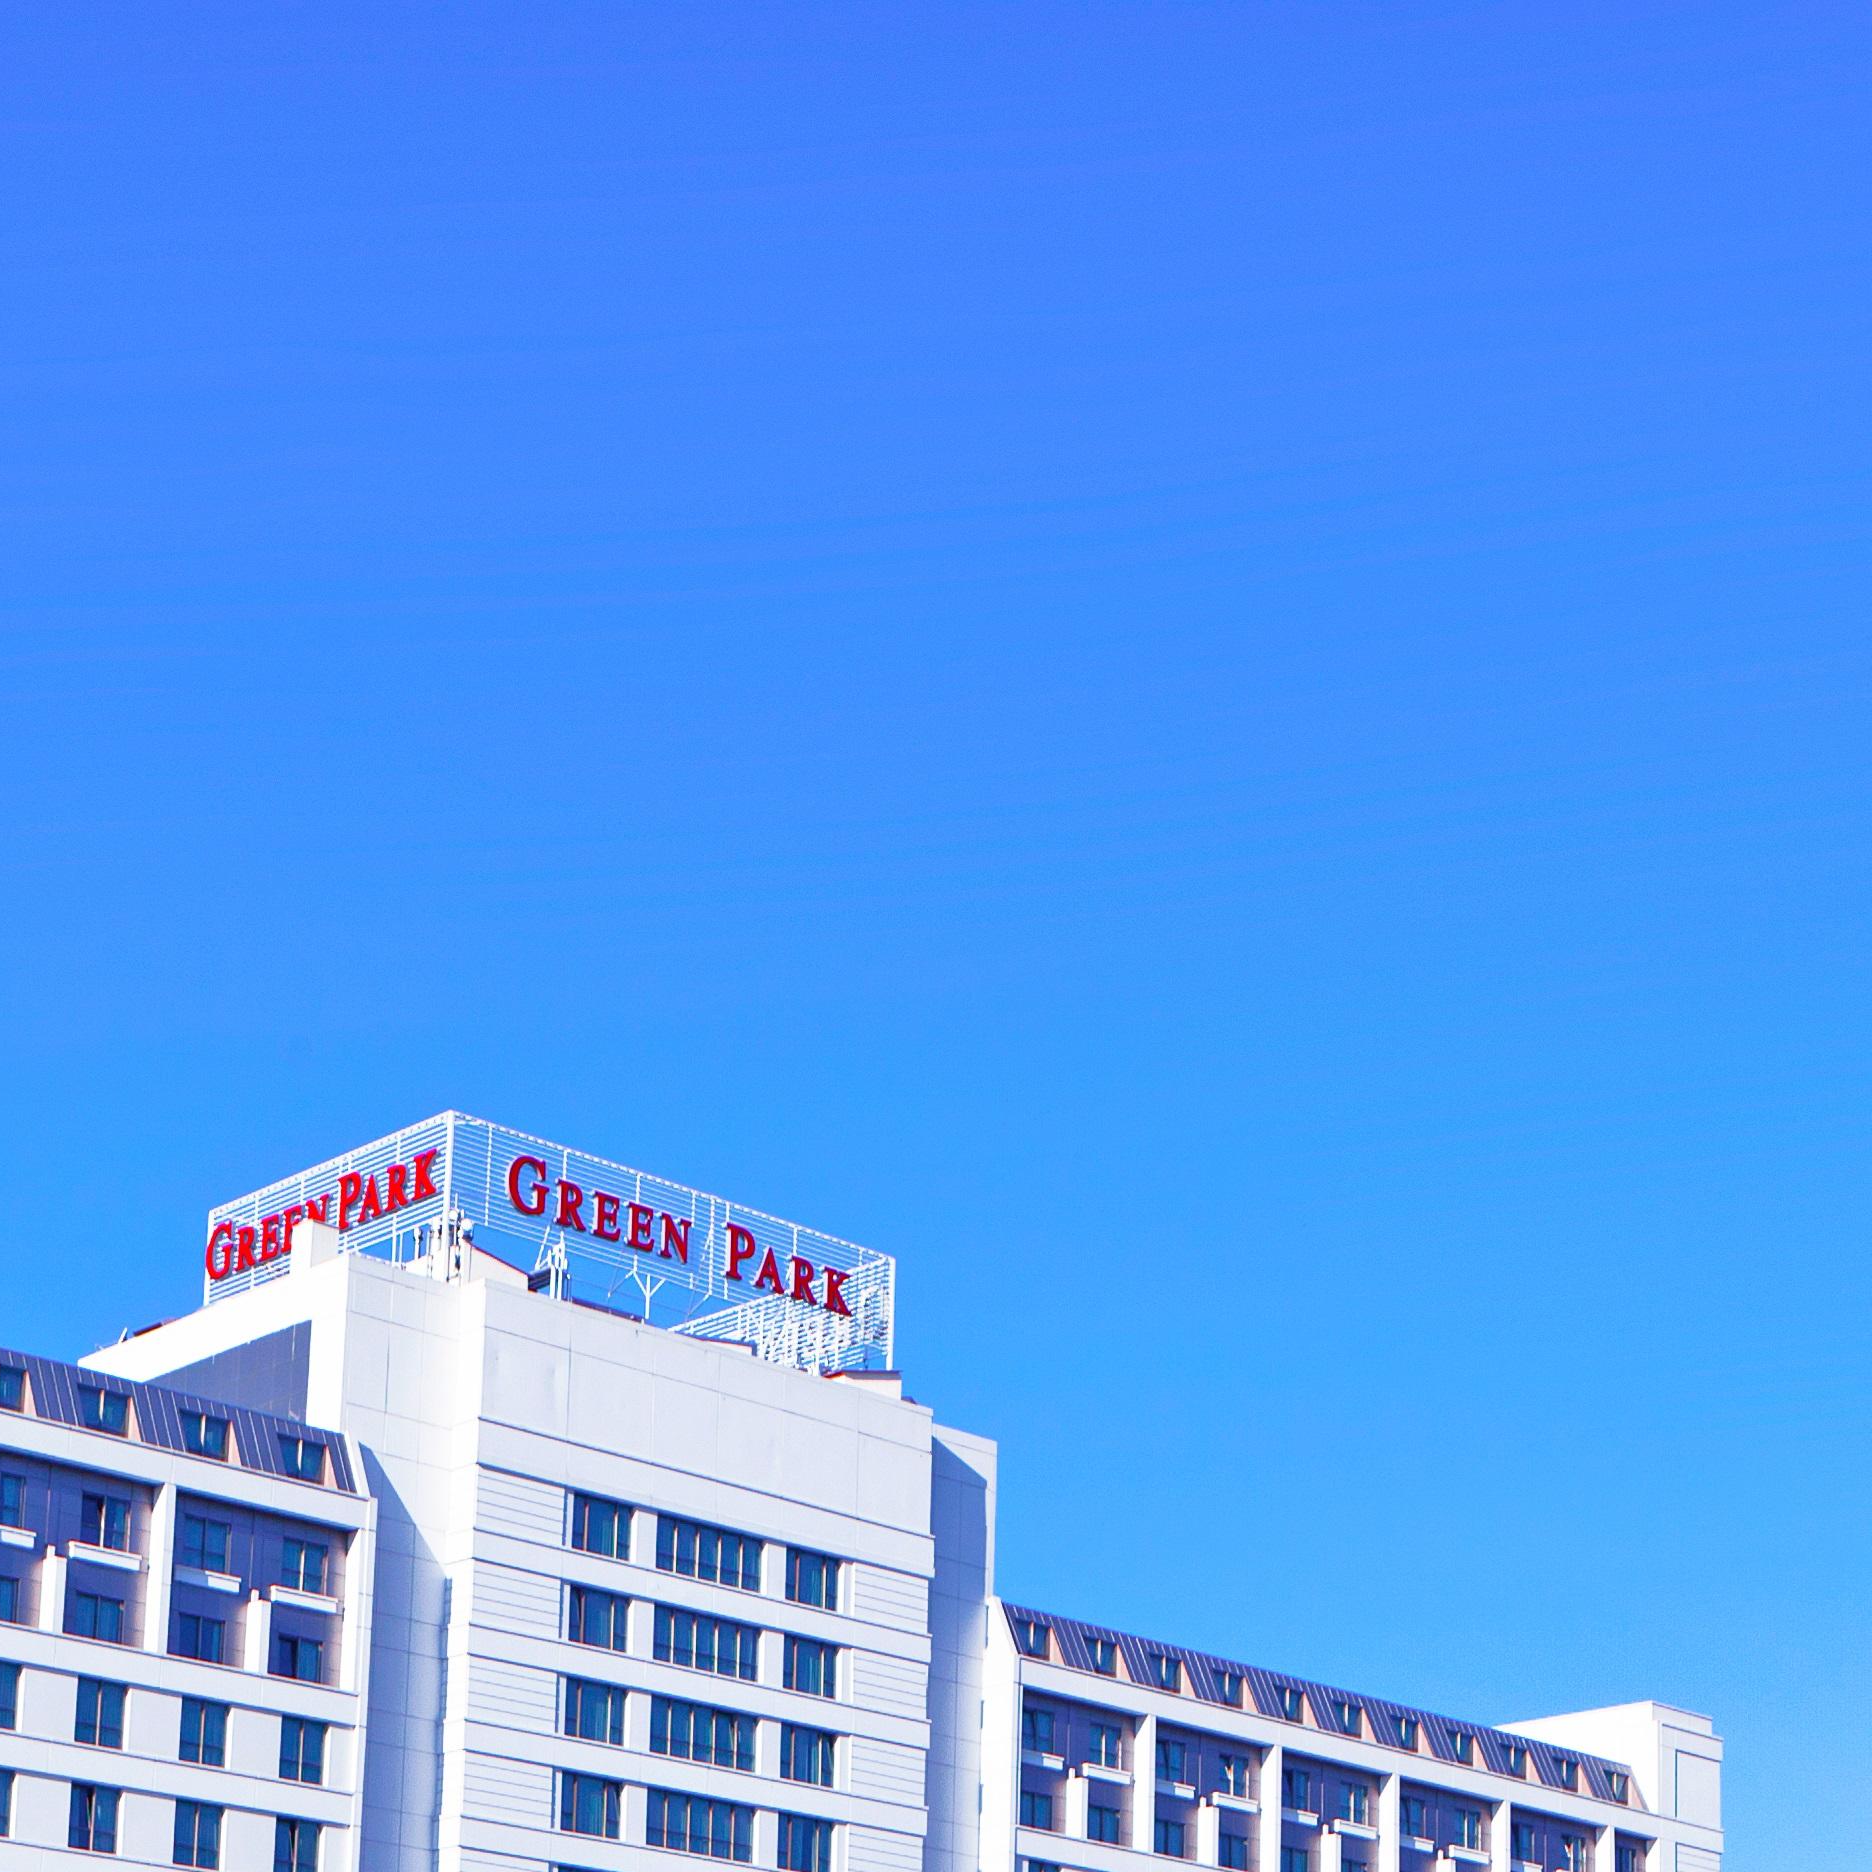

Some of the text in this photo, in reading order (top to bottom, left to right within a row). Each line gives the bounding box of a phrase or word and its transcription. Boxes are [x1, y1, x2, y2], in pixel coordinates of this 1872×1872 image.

[337, 1148, 438, 1231] PARK
[507, 1155, 853, 1317] GREEN PARK
